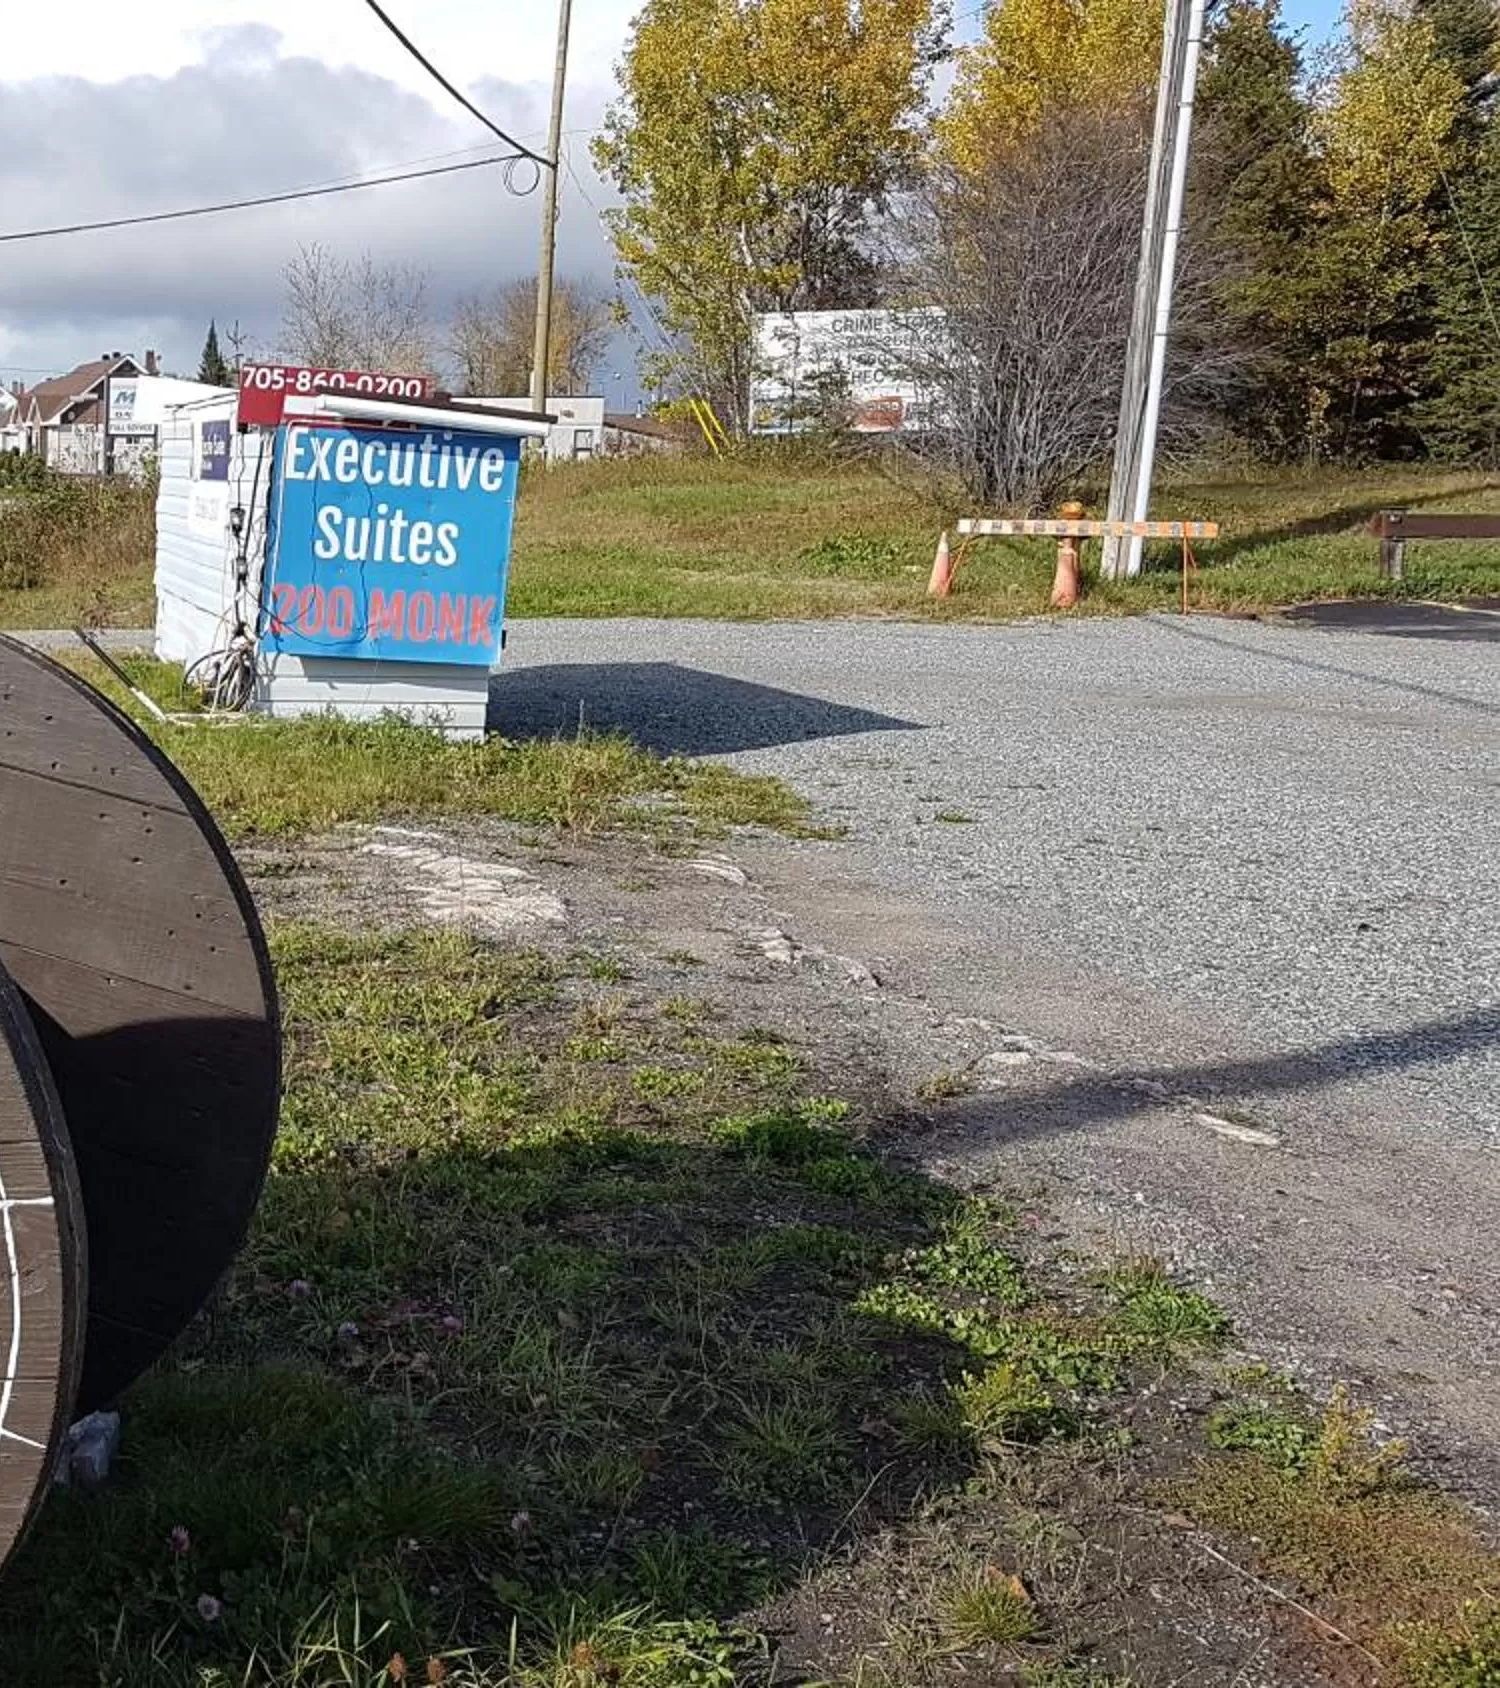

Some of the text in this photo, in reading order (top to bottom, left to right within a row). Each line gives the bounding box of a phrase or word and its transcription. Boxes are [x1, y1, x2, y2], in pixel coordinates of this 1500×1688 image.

[831, 316, 884, 333] CRIME
[284, 426, 505, 491] Executive
[314, 503, 460, 567] Suites
[270, 583, 499, 647] 200 MONK
